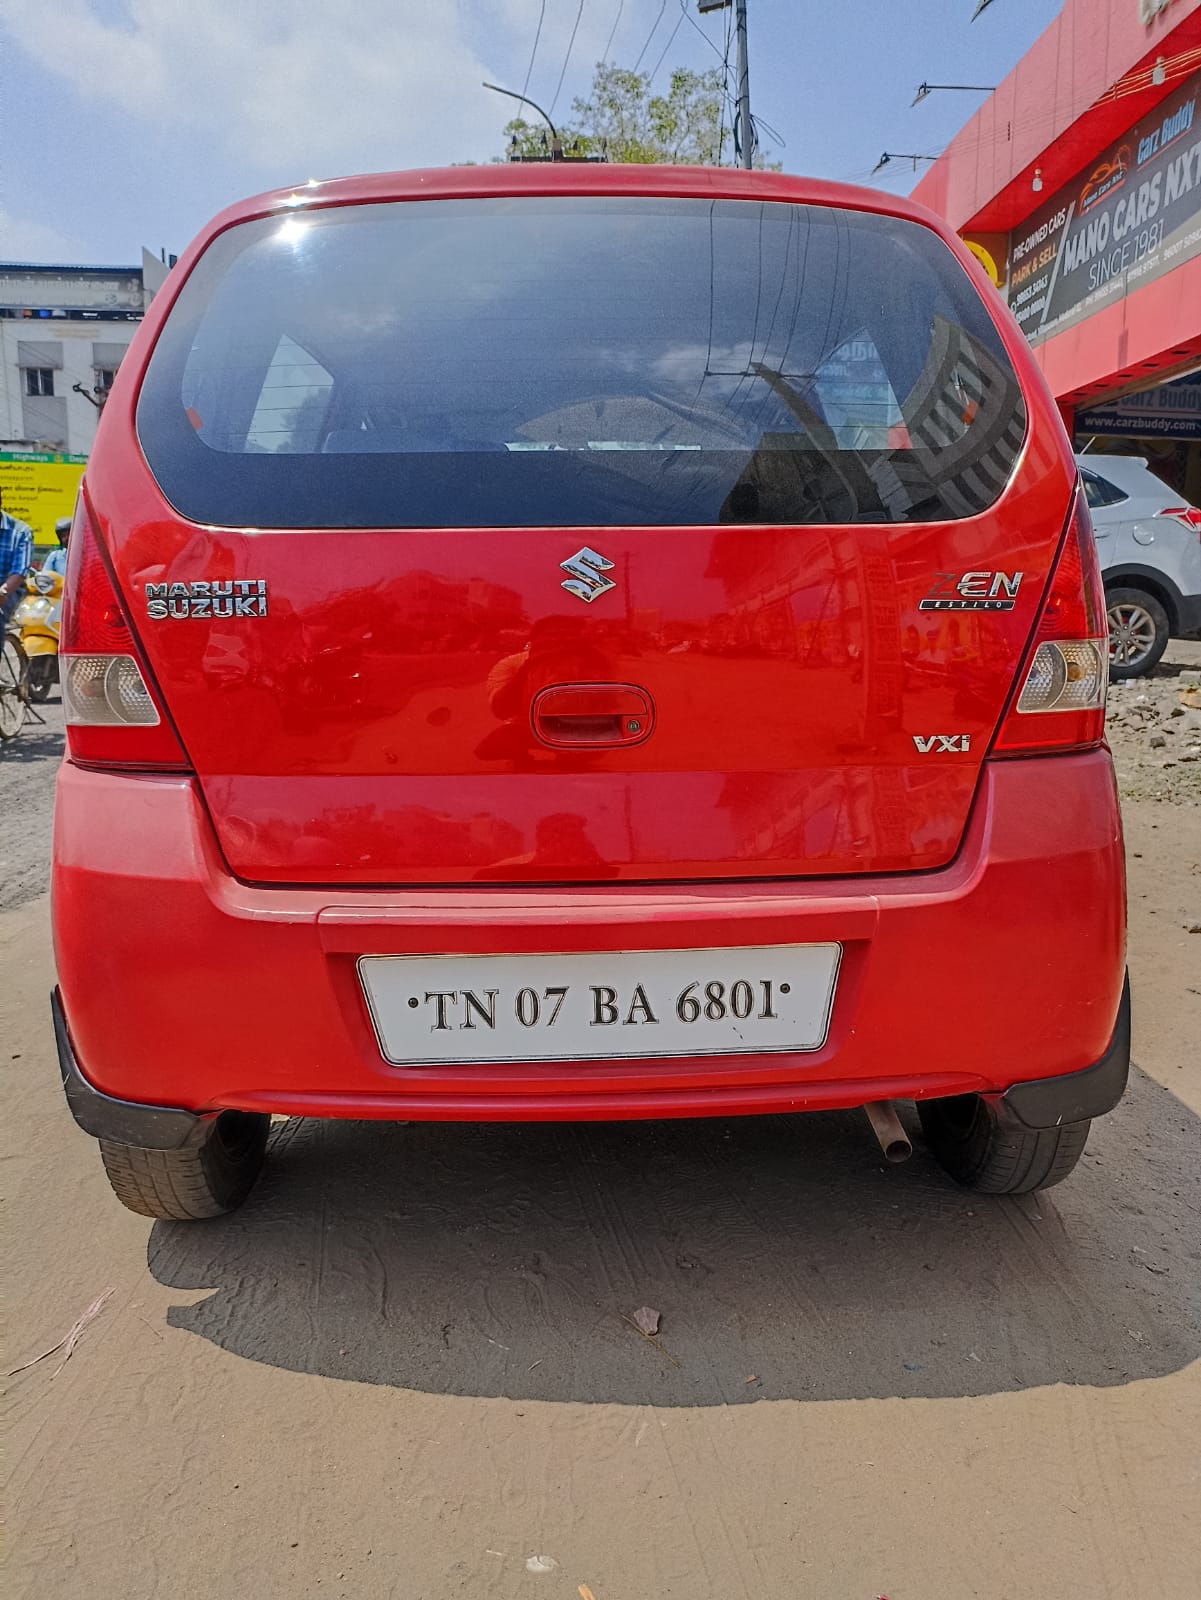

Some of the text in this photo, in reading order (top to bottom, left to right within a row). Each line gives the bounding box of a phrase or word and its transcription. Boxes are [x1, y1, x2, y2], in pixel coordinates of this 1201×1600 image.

[1137, 98, 1195, 165] Carz Buddy
[1063, 211, 1111, 277] MANO
[1112, 171, 1163, 242] CARS
[1163, 138, 1201, 209] NXT
[1013, 207, 1066, 263] PRE-OWNED CARS
[1088, 240, 1132, 291] SINCE
[1134, 219, 1164, 263] 1981
[1011, 242, 1057, 288] PARK & SELL
[1084, 417, 1196, 431] www.carzbuddy.com
[145, 579, 267, 598] MARUTI
[927, 571, 1024, 597] ZEN
[146, 597, 268, 620] SUZUKI
[912, 735, 970, 753] VXi
[423, 979, 778, 1032] TN 07 BA 6801
